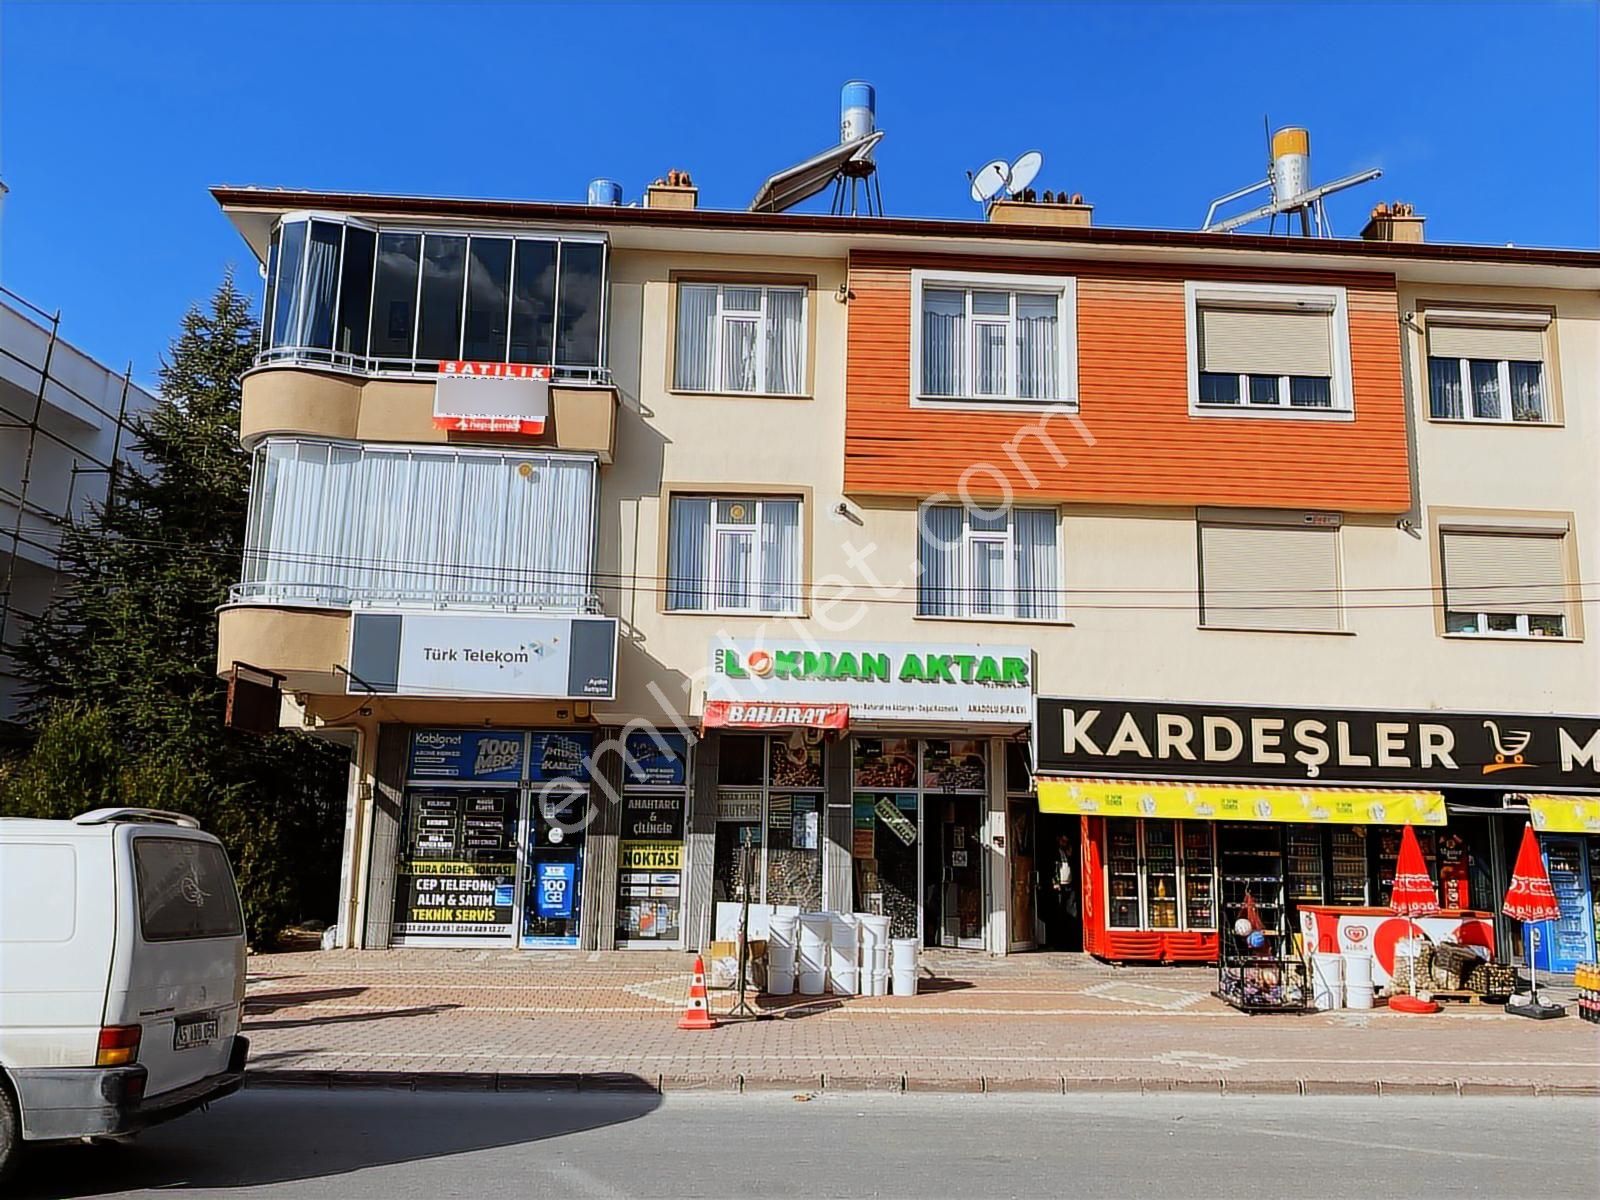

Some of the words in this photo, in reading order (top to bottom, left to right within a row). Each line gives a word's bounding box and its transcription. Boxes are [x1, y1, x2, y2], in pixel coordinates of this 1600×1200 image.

[444, 362, 544, 378] SATILIK
[424, 648, 457, 661] Türk
[464, 649, 528, 663] Telekom
[715, 648, 724, 673] DVD
[898, 653, 1029, 686] AKTAR
[727, 705, 829, 725] BAHARAT
[968, 705, 999, 714] ANADOLU
[478, 738, 519, 755] 1000
[1062, 708, 1459, 777] KARDEŞLER
[623, 851, 679, 867] NOKTASI
[440, 863, 474, 875] ÖDEME
[475, 864, 512, 876] NOKTASI
[416, 878, 438, 891] CEP
[440, 879, 496, 892] TELEFONU
[542, 880, 566, 892] 100
[416, 893, 445, 906] ALIM
[447, 894, 456, 906] &
[458, 894, 493, 907] SATIM
[545, 891, 563, 903] GB
[412, 907, 453, 921] TEKNİK
[455, 907, 496, 922] SERVİS
